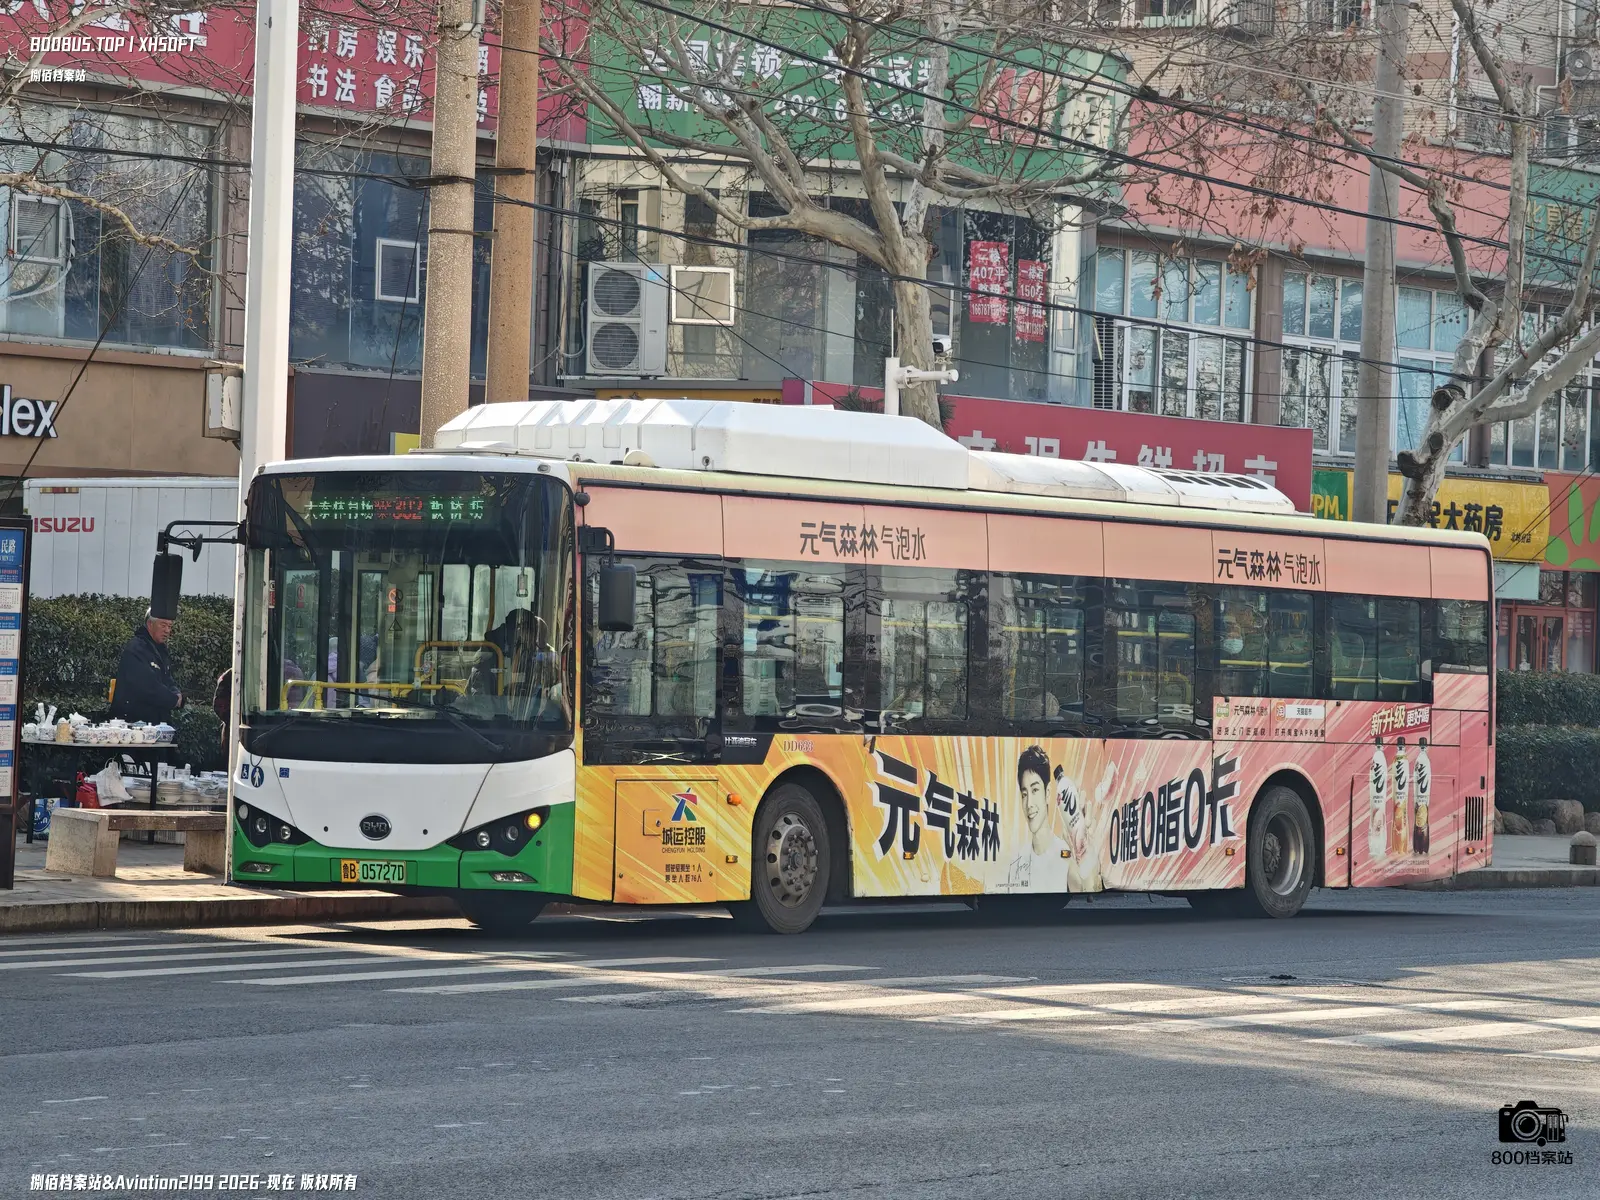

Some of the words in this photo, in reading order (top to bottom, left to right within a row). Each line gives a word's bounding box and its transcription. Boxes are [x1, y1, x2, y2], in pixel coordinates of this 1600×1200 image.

[308, 63, 356, 104] 书法
[0, 384, 58, 438] lex
[34, 517, 95, 533] ISUZU
[800, 521, 926, 560] 元气森林气泡水
[1218, 548, 1321, 585] 元气森林气泡水
[1370, 704, 1406, 736] 新升级
[872, 750, 1000, 862] 元气森林
[363, 821, 387, 832] BYD
[662, 827, 706, 846] 城运控股
